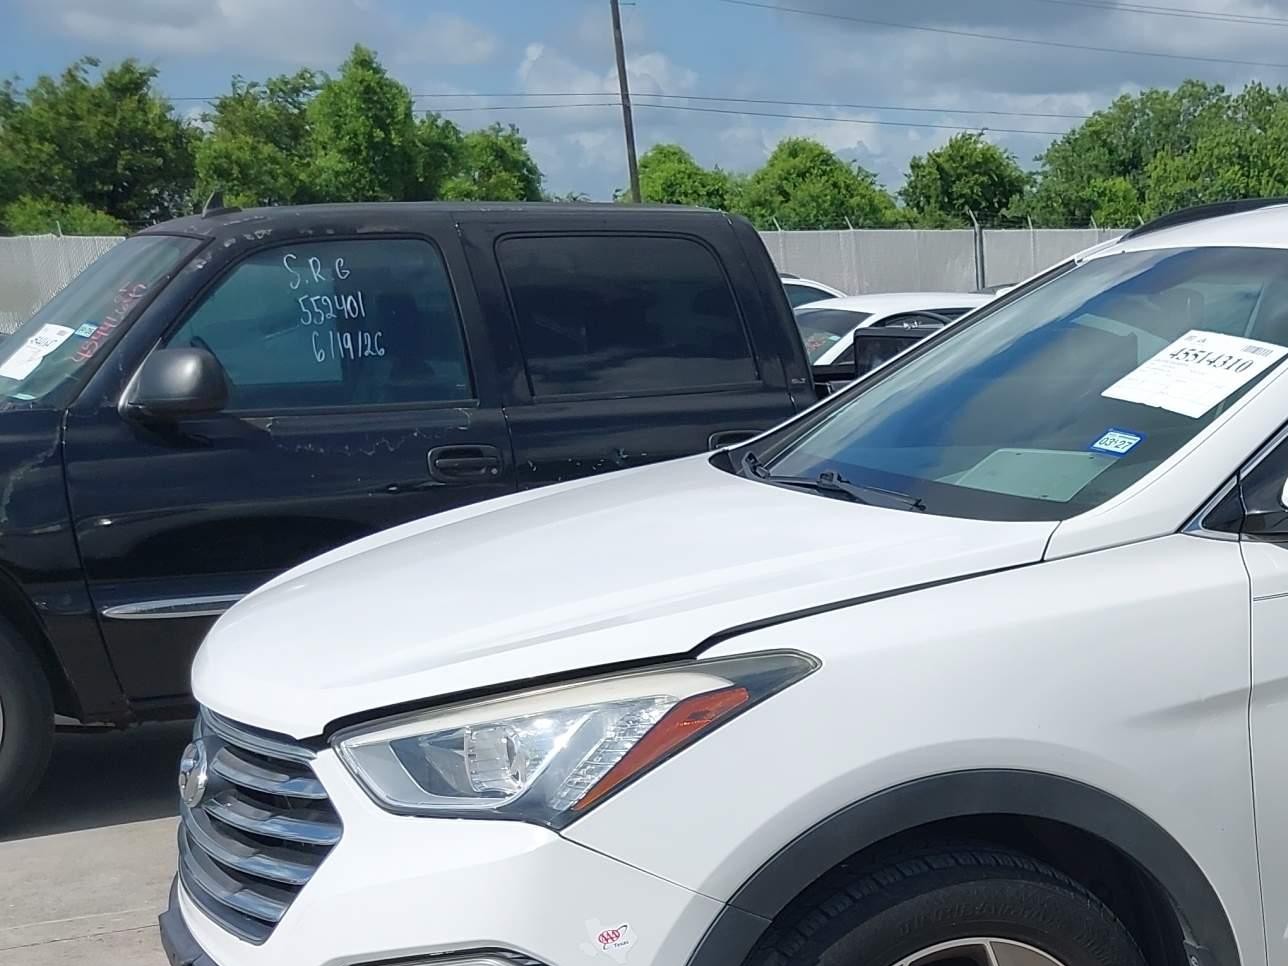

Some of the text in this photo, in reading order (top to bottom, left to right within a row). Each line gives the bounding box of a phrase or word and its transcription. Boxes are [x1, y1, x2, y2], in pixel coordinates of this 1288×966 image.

[298, 291, 366, 325] 552401
[311, 330, 385, 362] 6/19/26
[1169, 347, 1255, 373] 45514310
